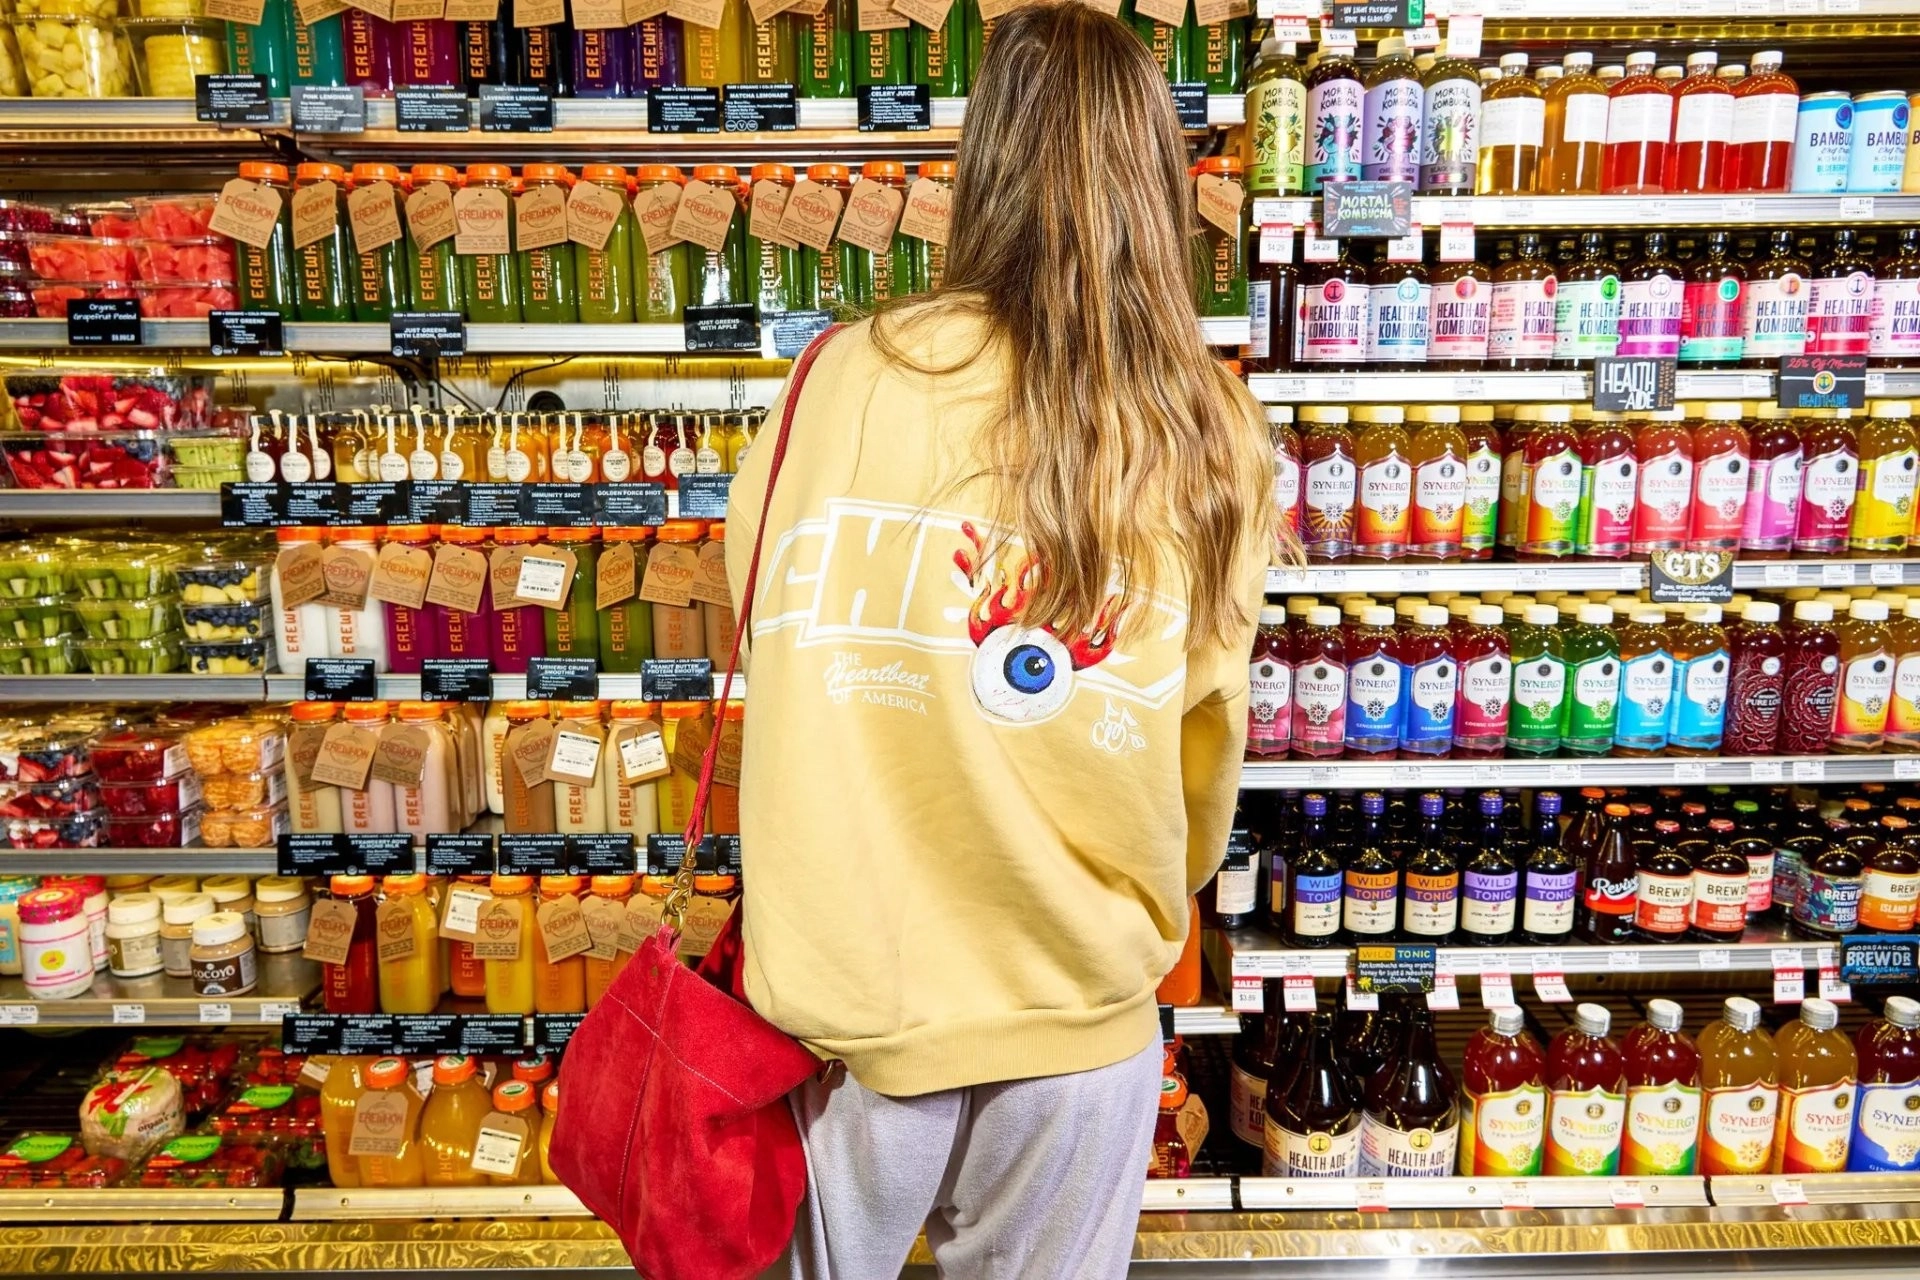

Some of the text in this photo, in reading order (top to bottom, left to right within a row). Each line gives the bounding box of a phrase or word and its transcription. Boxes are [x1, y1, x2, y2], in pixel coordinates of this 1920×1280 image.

[1261, 98, 1299, 110] KOMBUCHA
[1320, 97, 1358, 110] KOMBUCHA
[1432, 97, 1471, 110] KOMBUCHA
[224, 196, 274, 220] EREWHON
[1340, 196, 1392, 209] MORTAL
[457, 208, 504, 220] EREWHON
[569, 199, 615, 222] EREWHON
[684, 199, 729, 221] EREWHON
[792, 199, 835, 222] EREWHON
[1337, 206, 1394, 220] KOMBUCHA
[1308, 322, 1359, 338] KOMBUCHA
[1378, 322, 1428, 338] KOMBUCHA
[1435, 320, 1486, 336] KOMBUCHA
[833, 651, 862, 668] THE
[823, 660, 930, 692] Heartbeat
[1356, 678, 1398, 688] SYNERGY
[832, 689, 927, 715] OF AMERICA
[1310, 877, 1340, 890] WILD
[1356, 875, 1391, 887] WILD
[1416, 876, 1452, 888] WILD
[1476, 875, 1512, 887] WILD
[1540, 875, 1572, 887] WILD
[1306, 890, 1340, 902] TONIC
[1355, 888, 1391, 900] TONIC
[1415, 889, 1452, 901] TONIC
[1474, 888, 1512, 900] TONIC
[1538, 888, 1574, 900] TONIC
[1649, 884, 1681, 897] BREW
[1707, 884, 1741, 896] BREW
[1824, 888, 1856, 901] BREW
[1398, 950, 1430, 958] TONIC
[1846, 952, 1911, 966] BREW DR
[192, 964, 236, 979] COCOYO
[1560, 1116, 1619, 1134] SYNERGY
[1636, 1112, 1696, 1130] SYNERGY
